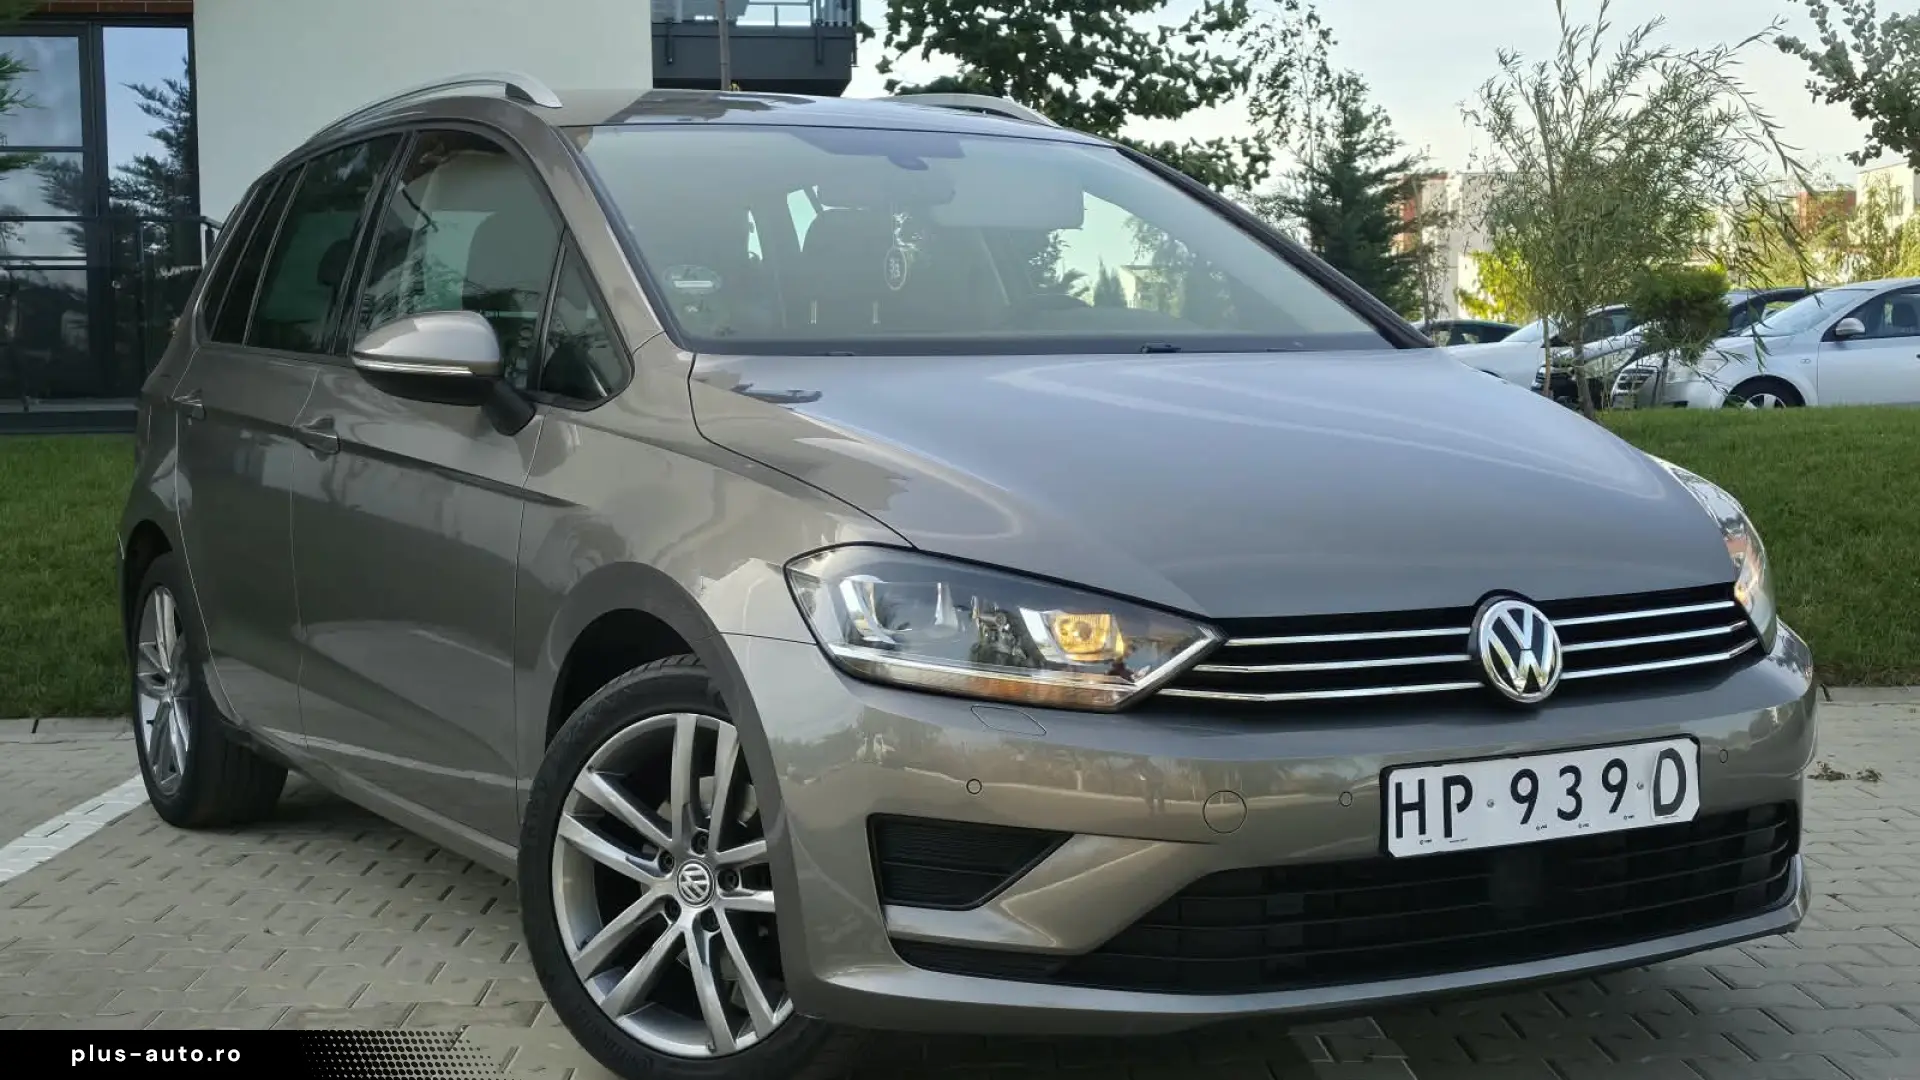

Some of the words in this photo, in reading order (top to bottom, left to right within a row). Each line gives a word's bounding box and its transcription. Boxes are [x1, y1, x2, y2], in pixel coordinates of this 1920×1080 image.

[1480, 600, 1562, 703] VW
[1395, 774, 1473, 839] HP
[1510, 757, 1629, 825] 939
[1652, 747, 1687, 817] D
